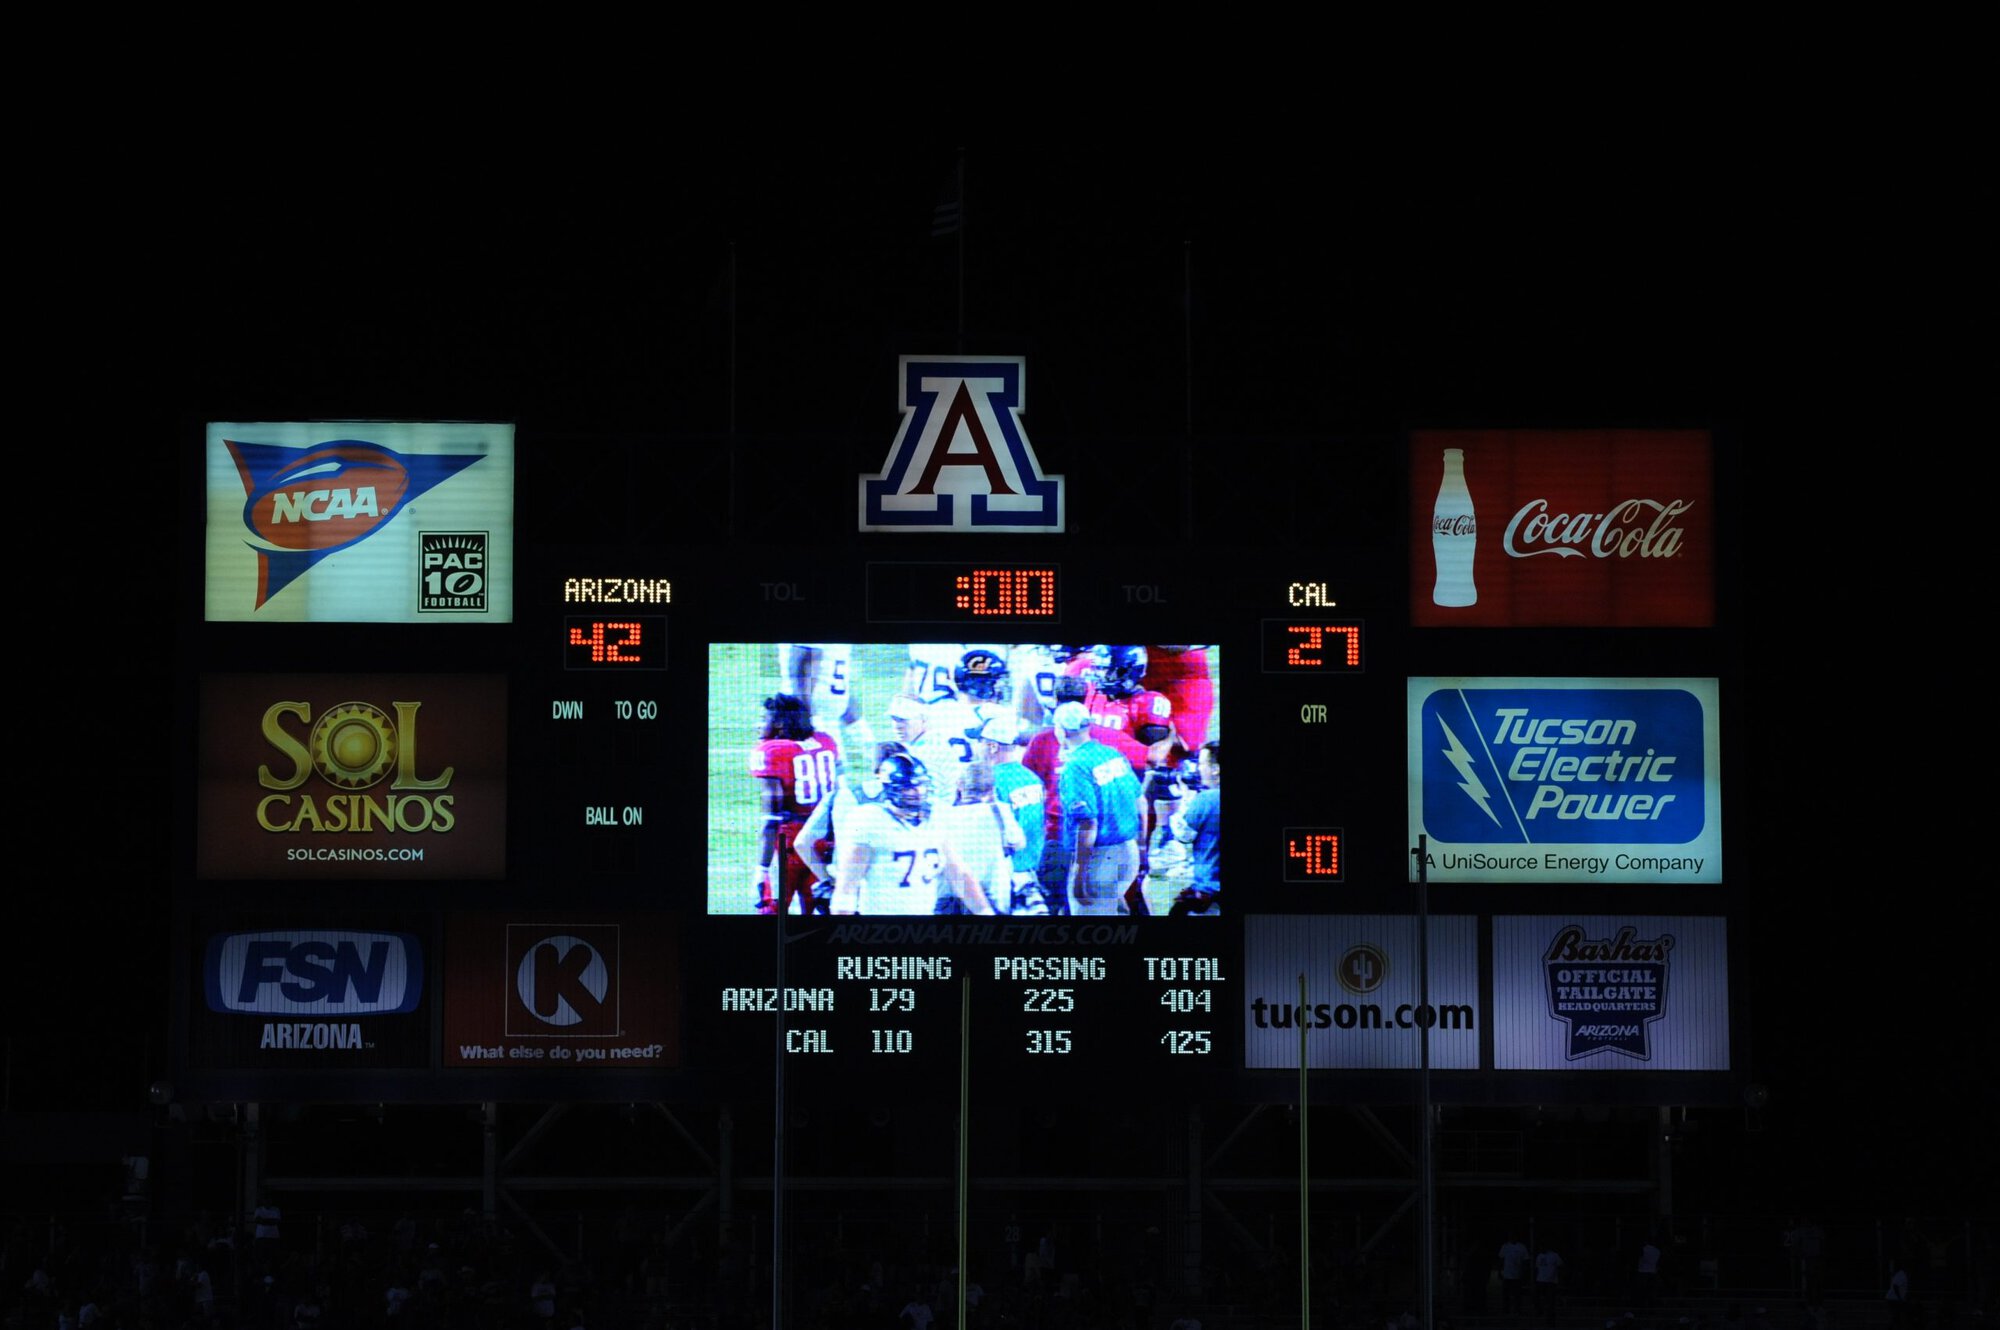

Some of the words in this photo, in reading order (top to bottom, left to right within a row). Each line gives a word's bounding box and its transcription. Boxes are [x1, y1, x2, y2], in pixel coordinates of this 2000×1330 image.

[271, 486, 379, 524] NCAA
[1503, 499, 1695, 559] Coca-Cola
[424, 553, 482, 569] PAC
[424, 571, 483, 596] 10
[565, 578, 671, 603] ARIZONA
[760, 582, 805, 602] TOL
[1122, 584, 1168, 604] TOL
[1287, 583, 1337, 607] CAL
[424, 597, 482, 607] FOOTBALL
[570, 622, 641, 662] 42
[1286, 624, 1360, 666] 27
[552, 701, 583, 720] DWN
[615, 701, 633, 720] TO
[637, 701, 657, 720] GO
[1300, 704, 1328, 724] QTR
[1493, 708, 1638, 745] Tucson
[258, 701, 454, 790] SOL
[1508, 747, 1677, 782] Electric
[257, 795, 455, 832] CASINOS
[1525, 785, 1676, 820] Power
[586, 806, 618, 825] BALL
[622, 806, 643, 825] ON
[287, 848, 424, 861] SOLCASINOS.COM
[1289, 834, 1339, 875] 40
[1443, 852, 1538, 870] UniSource
[1544, 853, 1609, 874] Energy
[1615, 853, 1705, 874] Company
[827, 923, 1139, 945] ARIZONAATHLETICS.COM
[238, 941, 391, 1004] FSN
[838, 957, 952, 980] RUSHING
[994, 957, 1106, 980] PASSING
[1143, 957, 1226, 981] TOTAL
[1556, 969, 1657, 984] OFFICIAL
[722, 988, 834, 1011] ARIZONA
[869, 988, 915, 1012] 179
[1024, 988, 1074, 1012] 225
[1161, 989, 1211, 1012] 404
[1556, 986, 1657, 1000] TAILGATE
[1251, 998, 1474, 1030] tucson.com
[1558, 1001, 1657, 1013] HEADQUARTERS
[260, 1022, 363, 1049] ARIZONA
[786, 1030, 834, 1053] CAL
[872, 1030, 912, 1053] 110
[1026, 1030, 1071, 1054] 315
[1573, 1024, 1640, 1037] ARIZONA
[460, 1045, 504, 1060] What
[509, 1045, 545, 1060] else
[549, 1045, 571, 1060] do
[575, 1047, 606, 1062] you
[610, 1044, 664, 1059] need?
